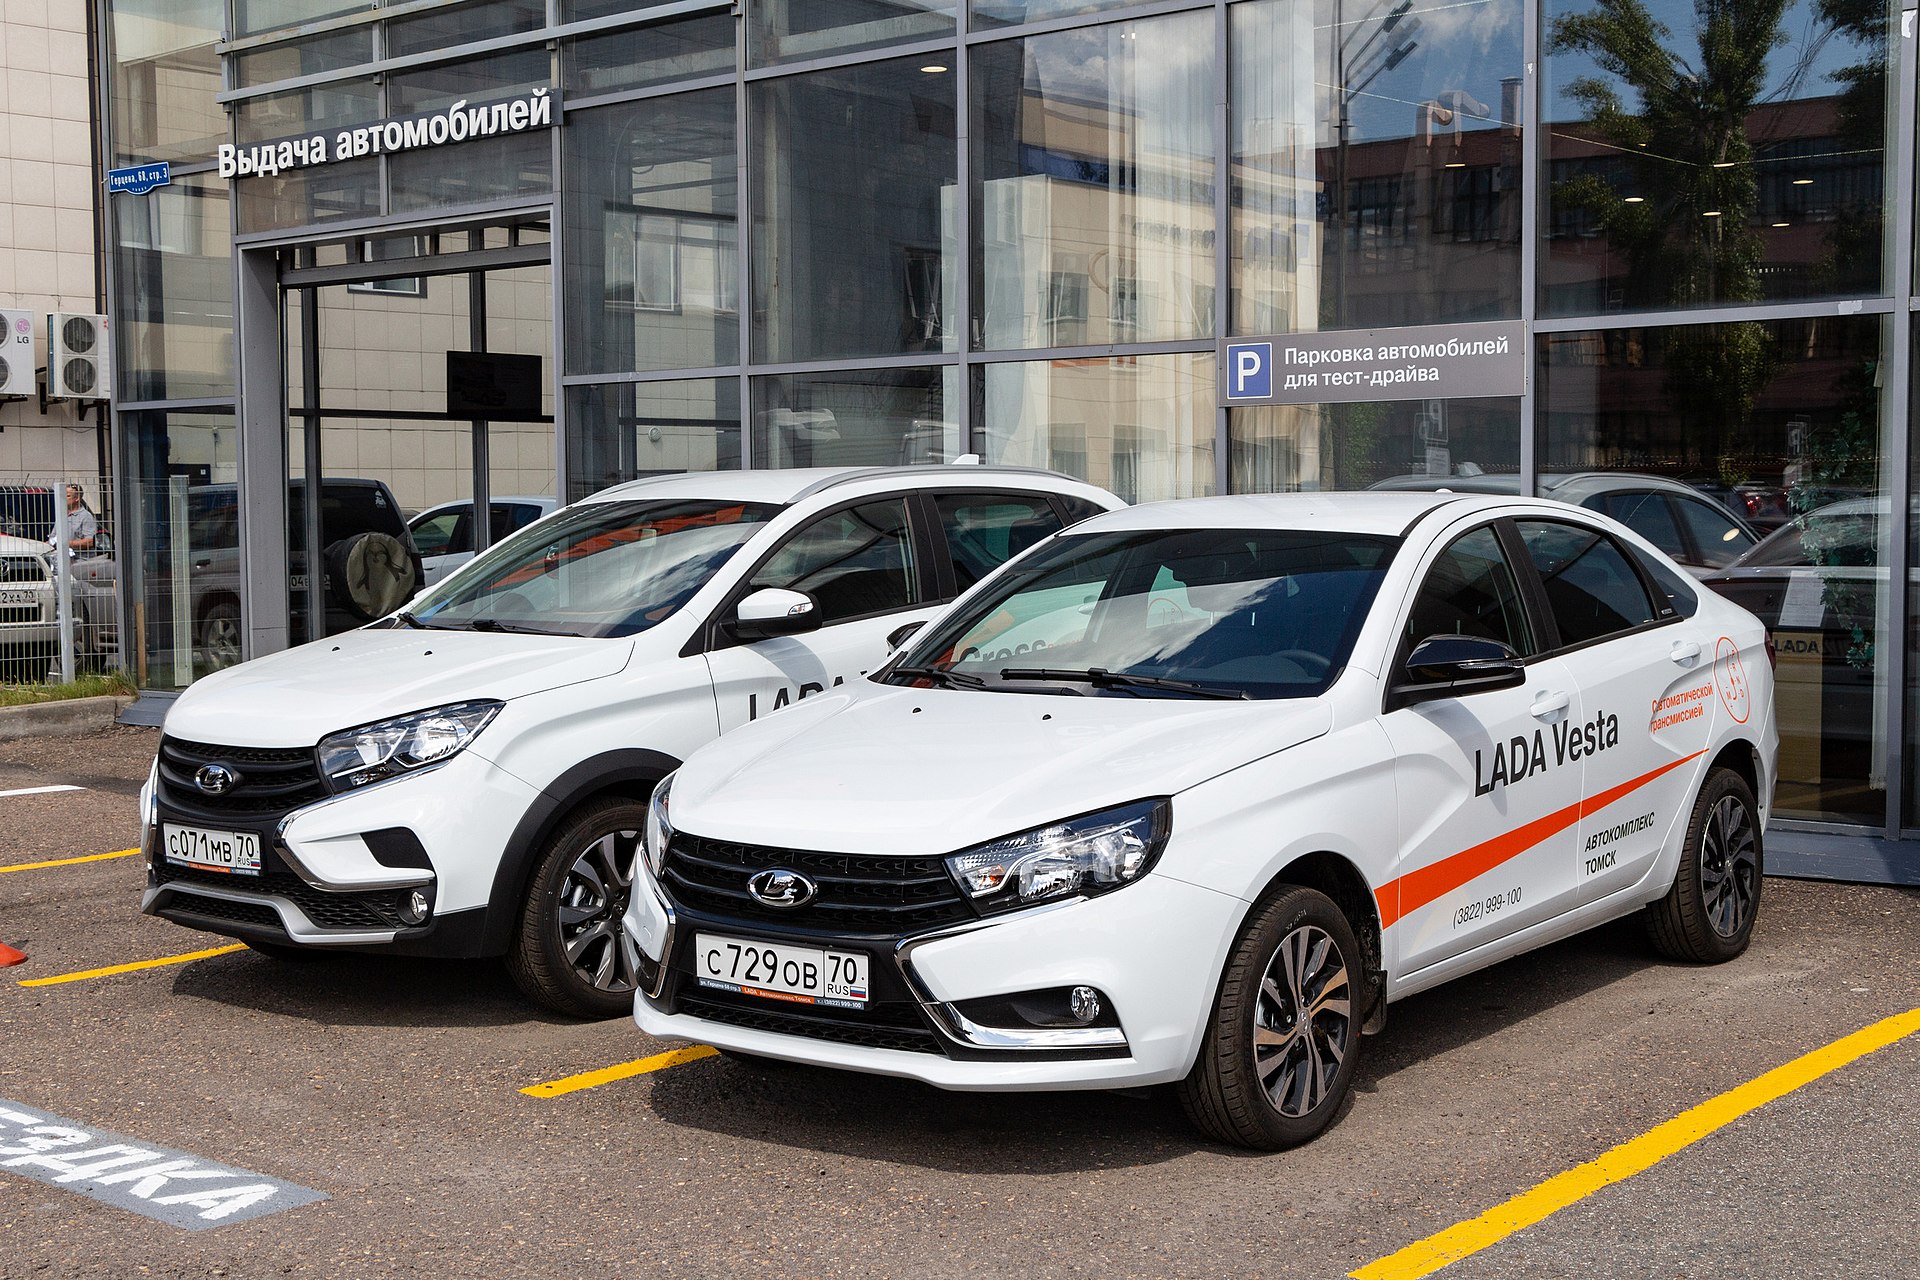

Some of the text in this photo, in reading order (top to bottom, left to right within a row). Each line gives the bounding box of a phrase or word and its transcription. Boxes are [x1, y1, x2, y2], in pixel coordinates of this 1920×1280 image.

[219, 87, 551, 178] Выдача автомобилей
[163, 167, 168, 178] 3
[16, 336, 29, 344] LG
[1284, 335, 1509, 367] Парковка автомобилей
[1284, 364, 1440, 390] для тест-драйва
[1774, 639, 1819, 653] LADA
[749, 676, 844, 721] LA
[1651, 702, 1704, 734] трансмиссией
[1475, 710, 1619, 798] LADA Vesta
[1585, 811, 1655, 853] АВТОКОМПЛЕКС
[236, 836, 254, 858] 70
[237, 857, 251, 866] RUS
[1585, 850, 1617, 876] ТОМСК
[1453, 886, 1522, 929] (3822) 999-100
[828, 955, 857, 985] 70
[828, 983, 849, 996] RUS
